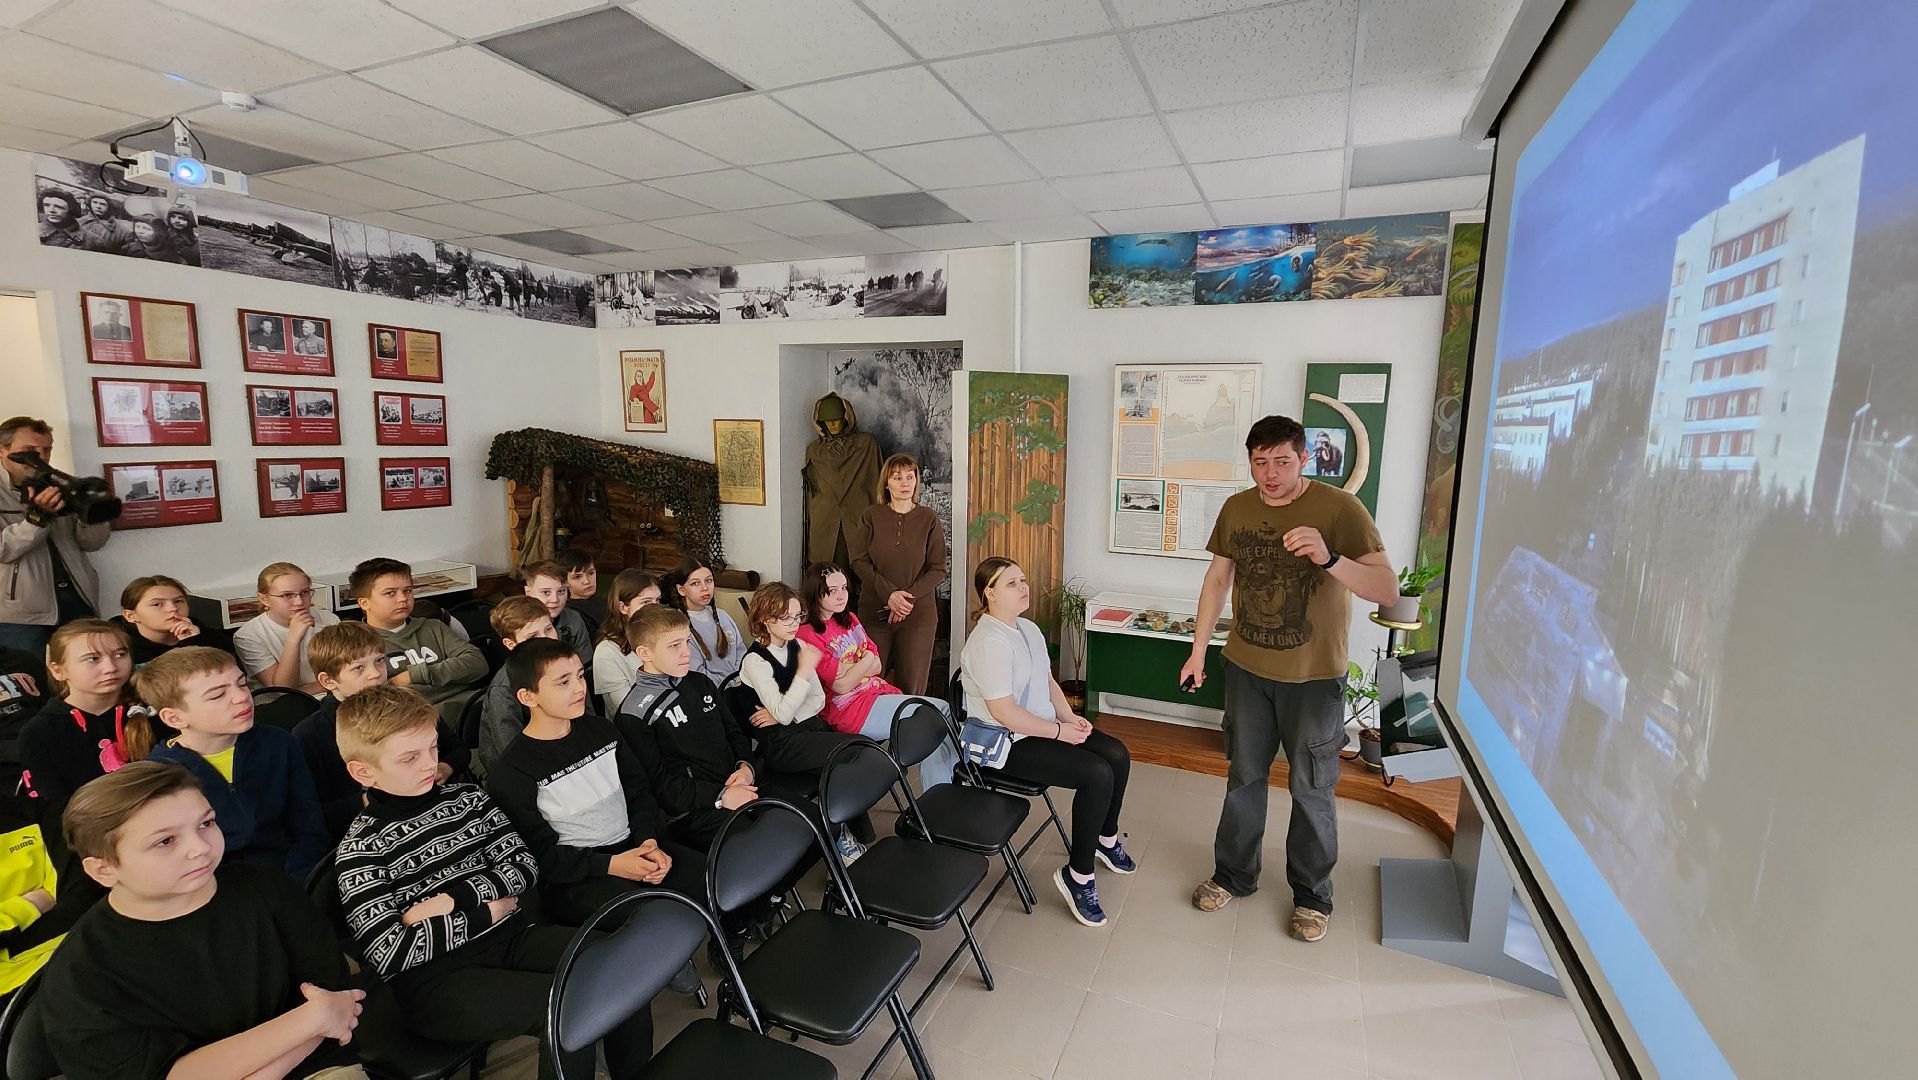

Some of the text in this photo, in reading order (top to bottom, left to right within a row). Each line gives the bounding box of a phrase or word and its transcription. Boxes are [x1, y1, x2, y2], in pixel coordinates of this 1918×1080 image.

[1253, 631, 1274, 645] MEN
[1277, 632, 1303, 645] ONLY
[665, 704, 688, 728] 14
[400, 806, 451, 834] KYBEAR
[9, 840, 34, 854] PUMA
[419, 832, 468, 863] KYBEAR
[425, 857, 477, 885] KYBEAR
